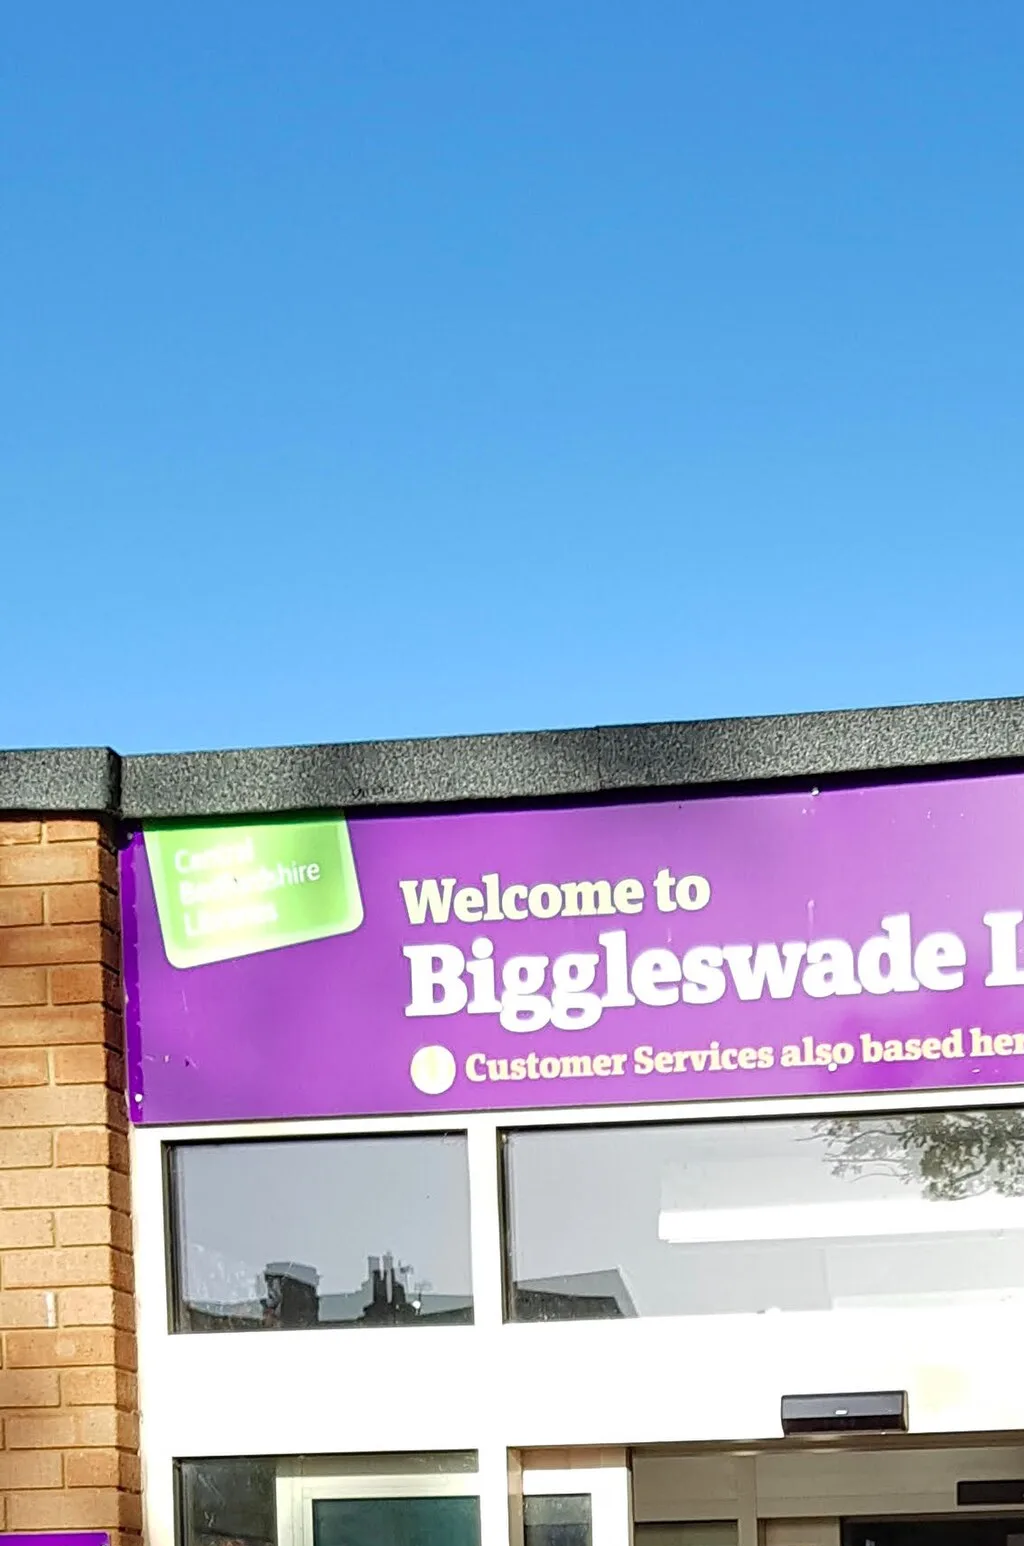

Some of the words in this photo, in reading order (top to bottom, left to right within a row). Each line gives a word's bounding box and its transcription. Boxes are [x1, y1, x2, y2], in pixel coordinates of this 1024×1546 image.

[400, 874, 644, 924] Welcome
[653, 868, 711, 912] to
[403, 912, 968, 1032] Biggleswade
[465, 1051, 627, 1082] Customer
[633, 1041, 774, 1075] Services
[781, 1036, 854, 1067] also
[860, 1029, 966, 1063] based
